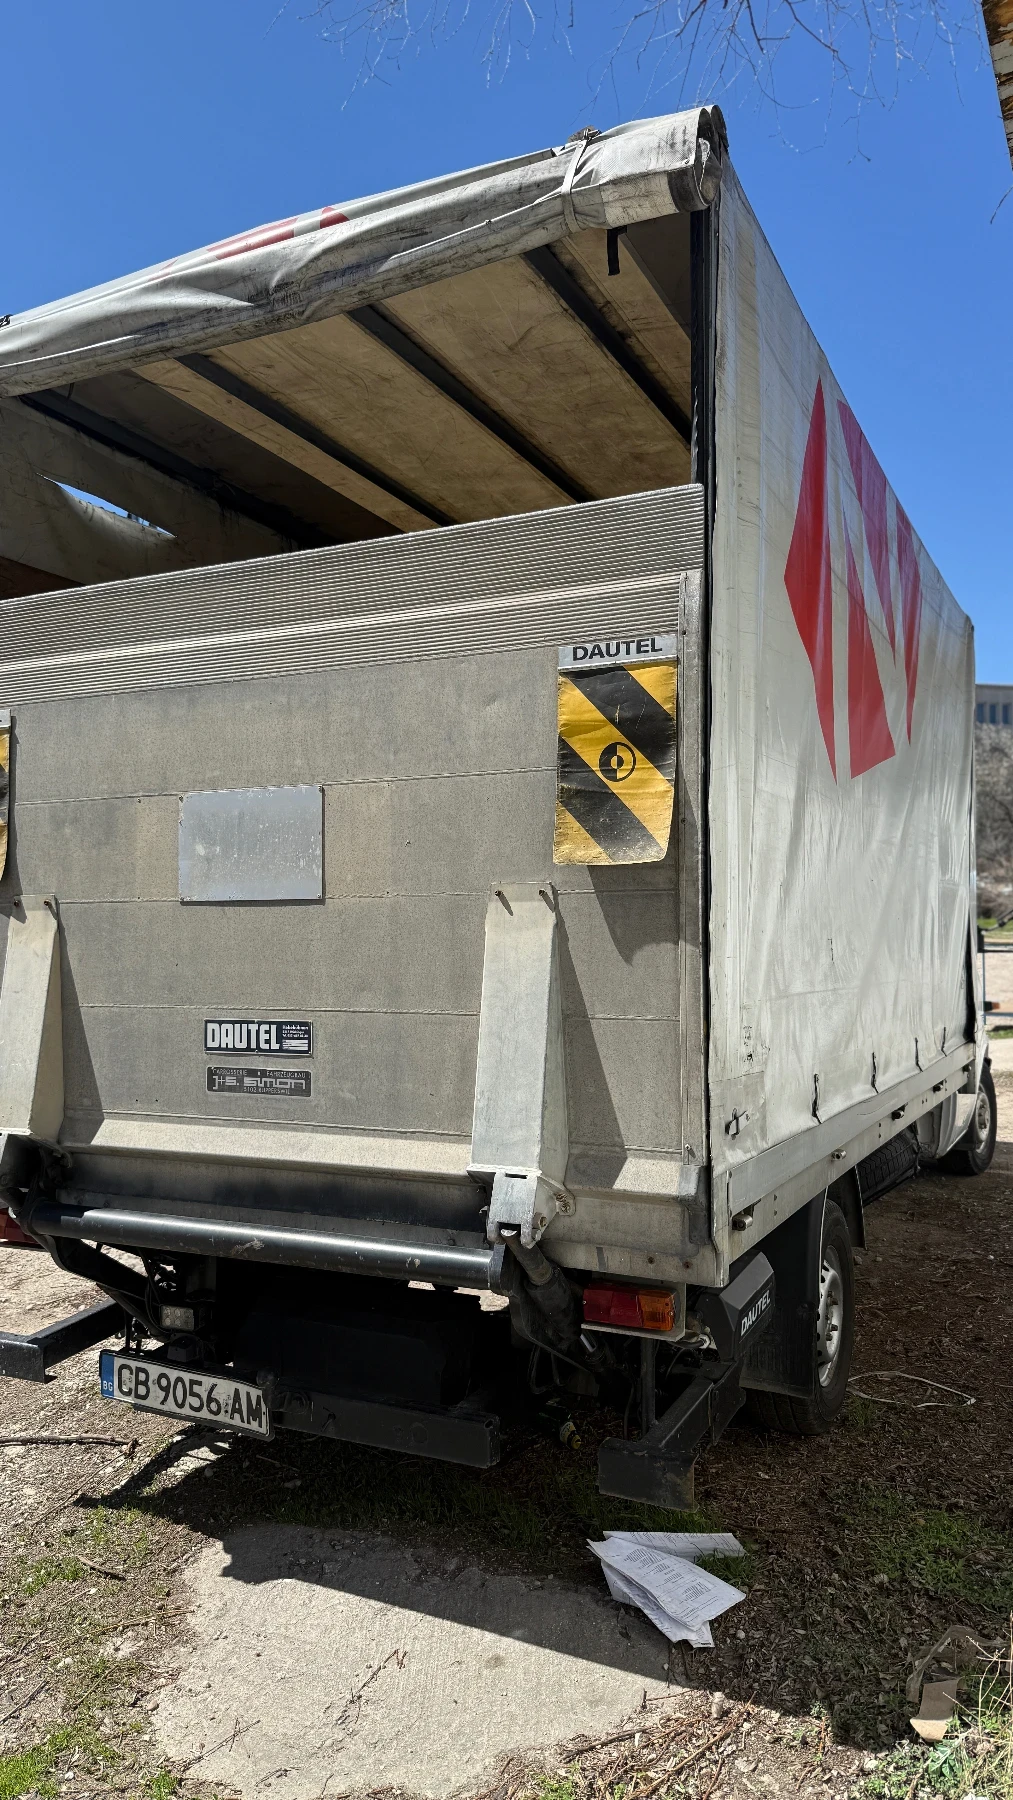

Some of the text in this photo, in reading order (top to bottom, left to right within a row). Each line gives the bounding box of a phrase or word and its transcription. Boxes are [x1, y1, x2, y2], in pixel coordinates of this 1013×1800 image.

[572, 637, 663, 662] DAUTEL
[206, 1022, 280, 1050] DAUTEL
[740, 1289, 771, 1337] DAUTEL
[102, 1380, 114, 1392] BG
[117, 1363, 263, 1429] CB 9056 AM
